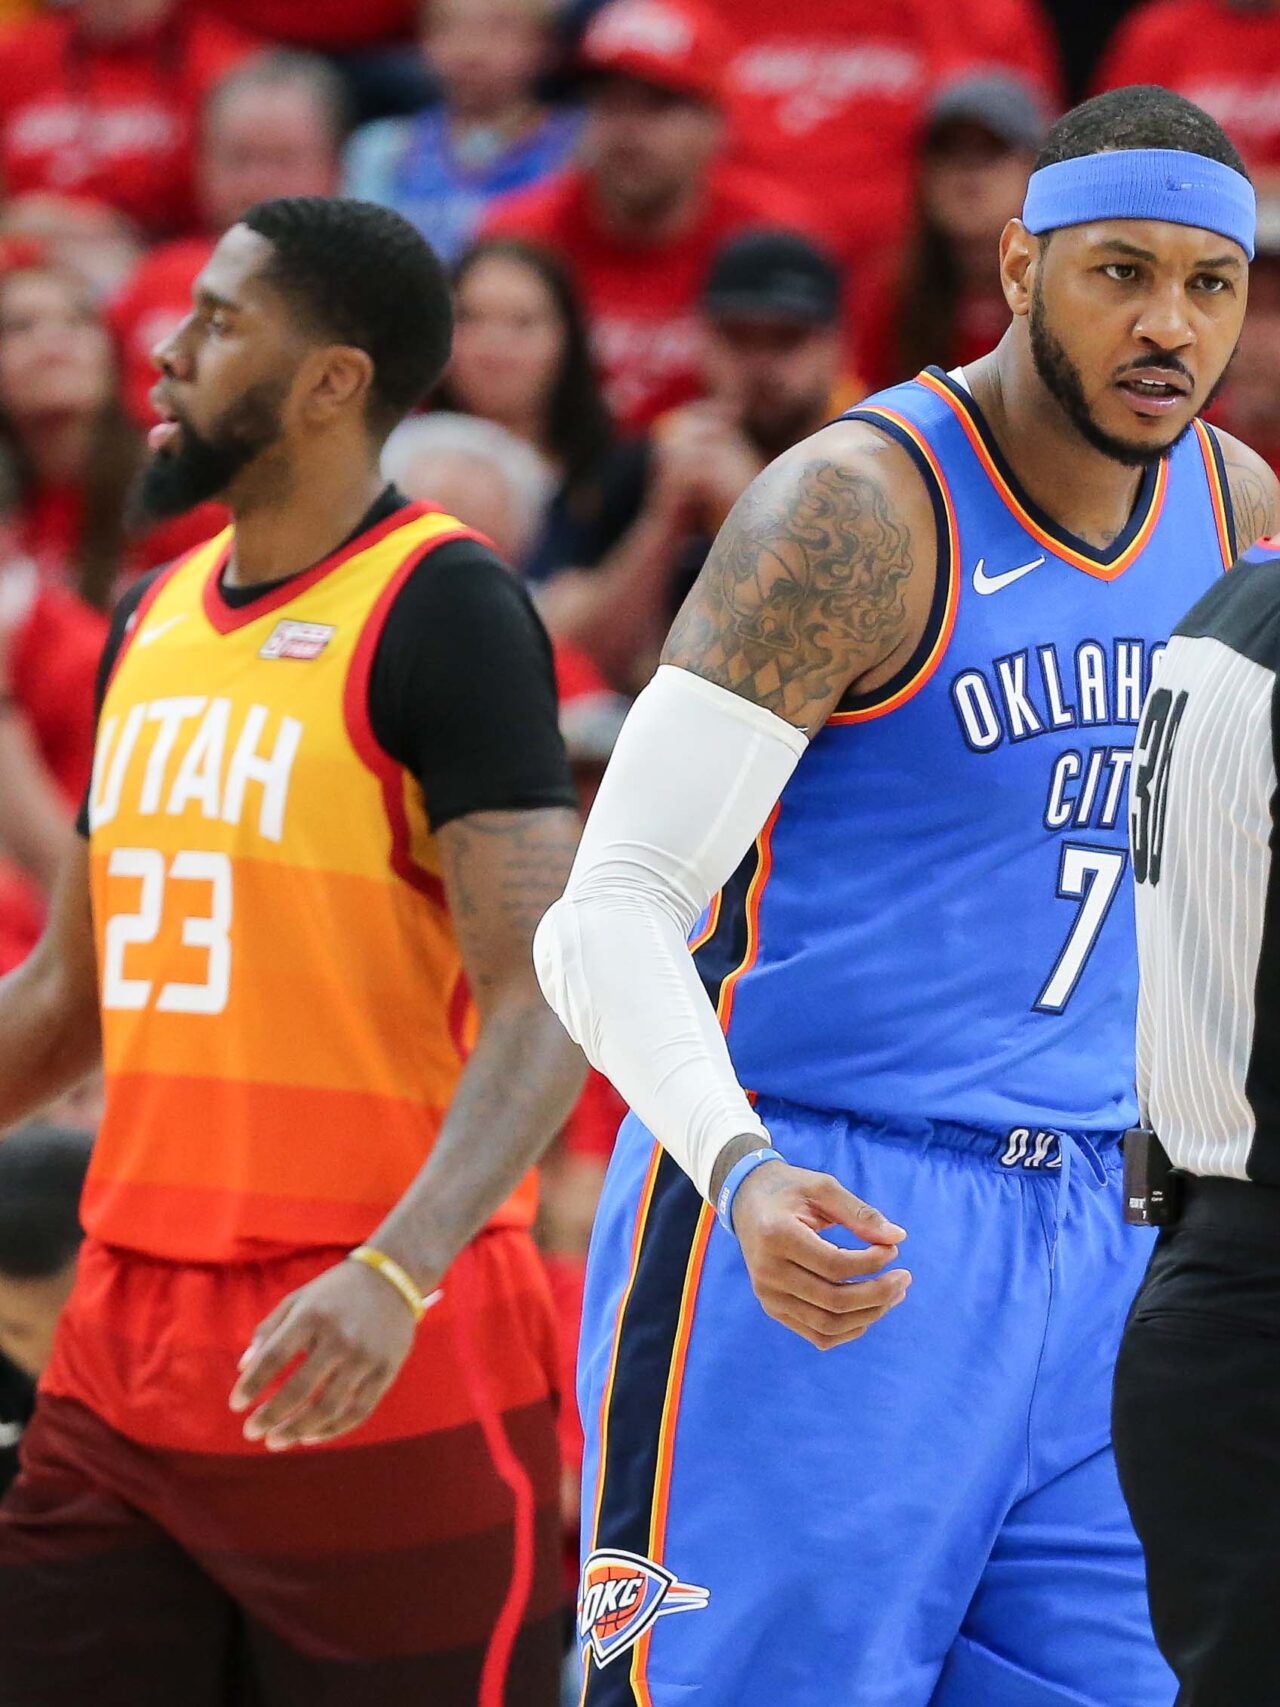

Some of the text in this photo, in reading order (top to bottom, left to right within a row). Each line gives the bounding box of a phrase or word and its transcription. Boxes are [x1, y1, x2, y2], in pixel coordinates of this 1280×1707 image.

[950, 637, 1167, 753] OKLAH
[89, 696, 303, 842] UTAH
[1042, 747, 1132, 831] CIT
[102, 848, 233, 1015] 23
[1032, 840, 1129, 1015] 7
[582, 1577, 643, 1637] OKC
